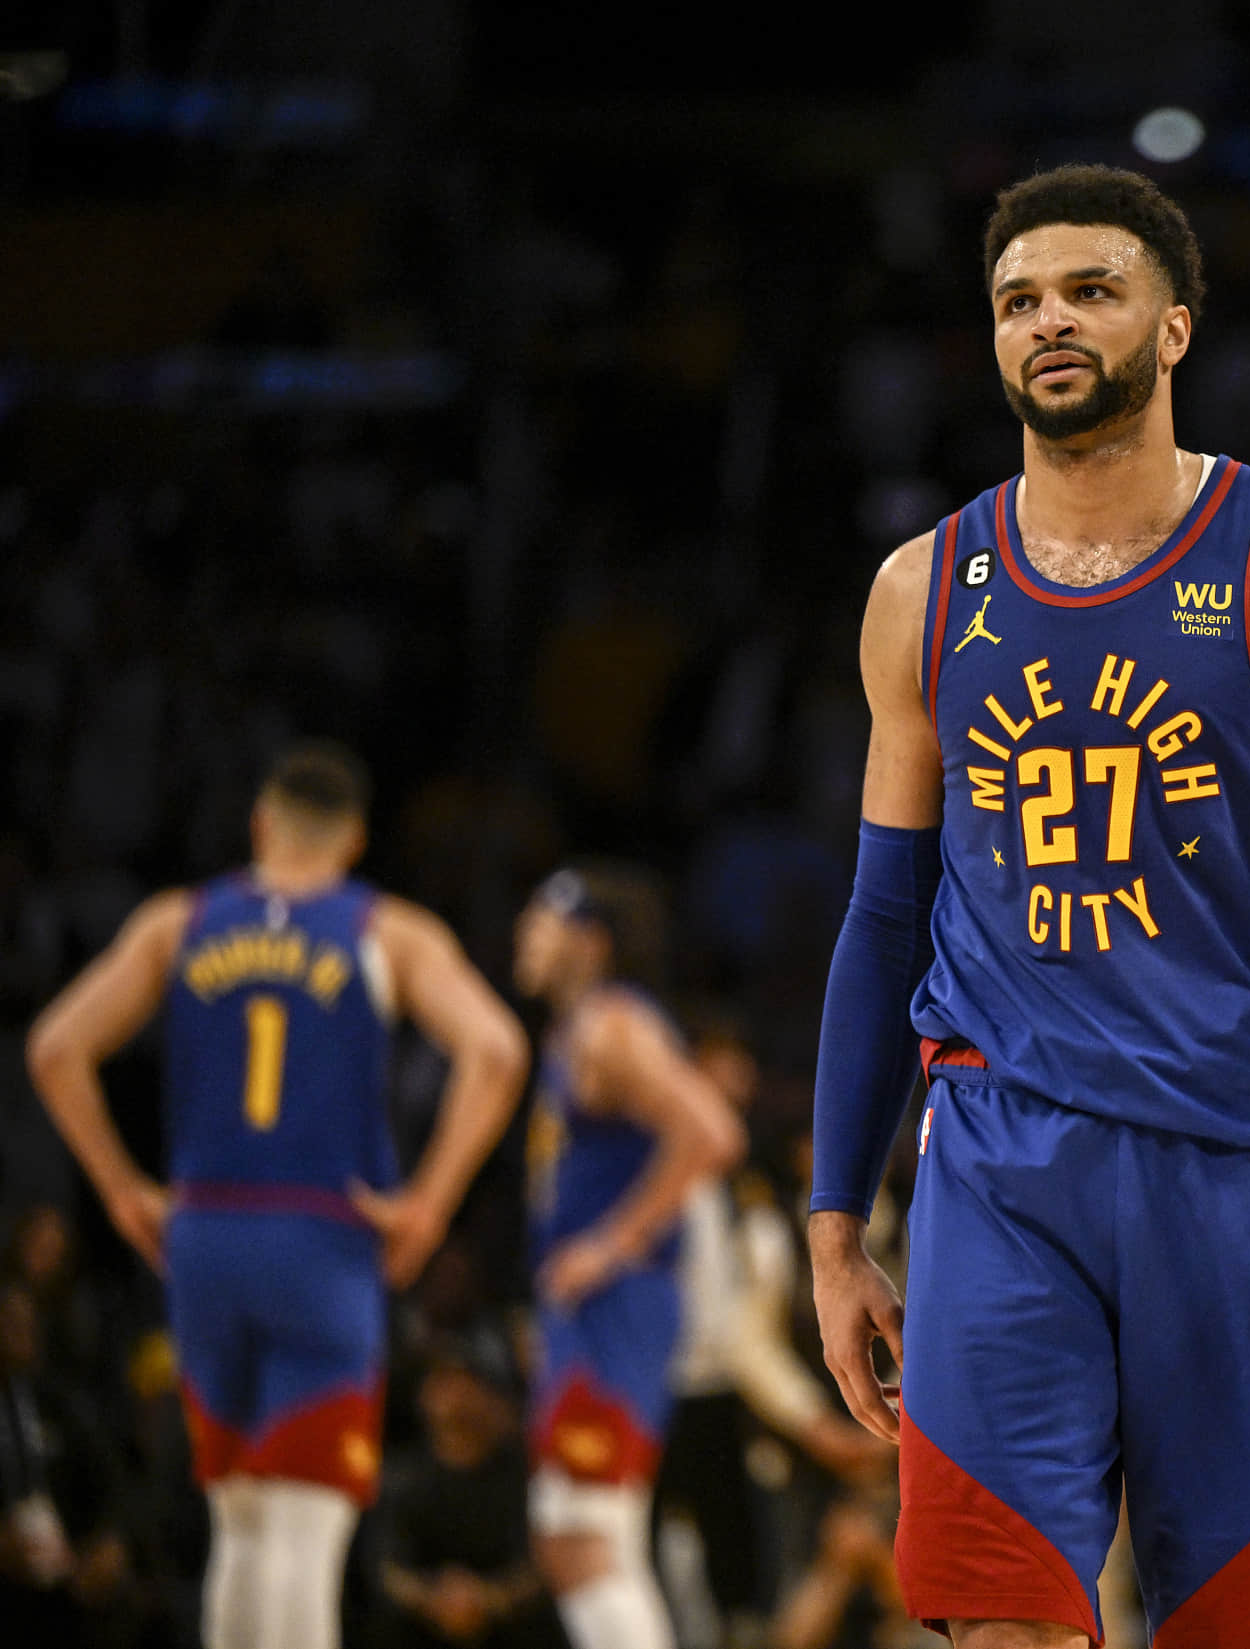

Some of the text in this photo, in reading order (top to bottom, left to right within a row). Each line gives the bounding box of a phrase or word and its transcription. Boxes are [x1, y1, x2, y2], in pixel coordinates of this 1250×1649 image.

[966, 553, 989, 585] 6
[1174, 581, 1233, 610] WU
[1172, 610, 1231, 625] Western
[1182, 623, 1221, 637] Union
[966, 652, 1222, 813] MILE HIGH
[1015, 745, 1143, 868] 27
[1027, 874, 1161, 953] CITY
[245, 995, 287, 1130] 1
